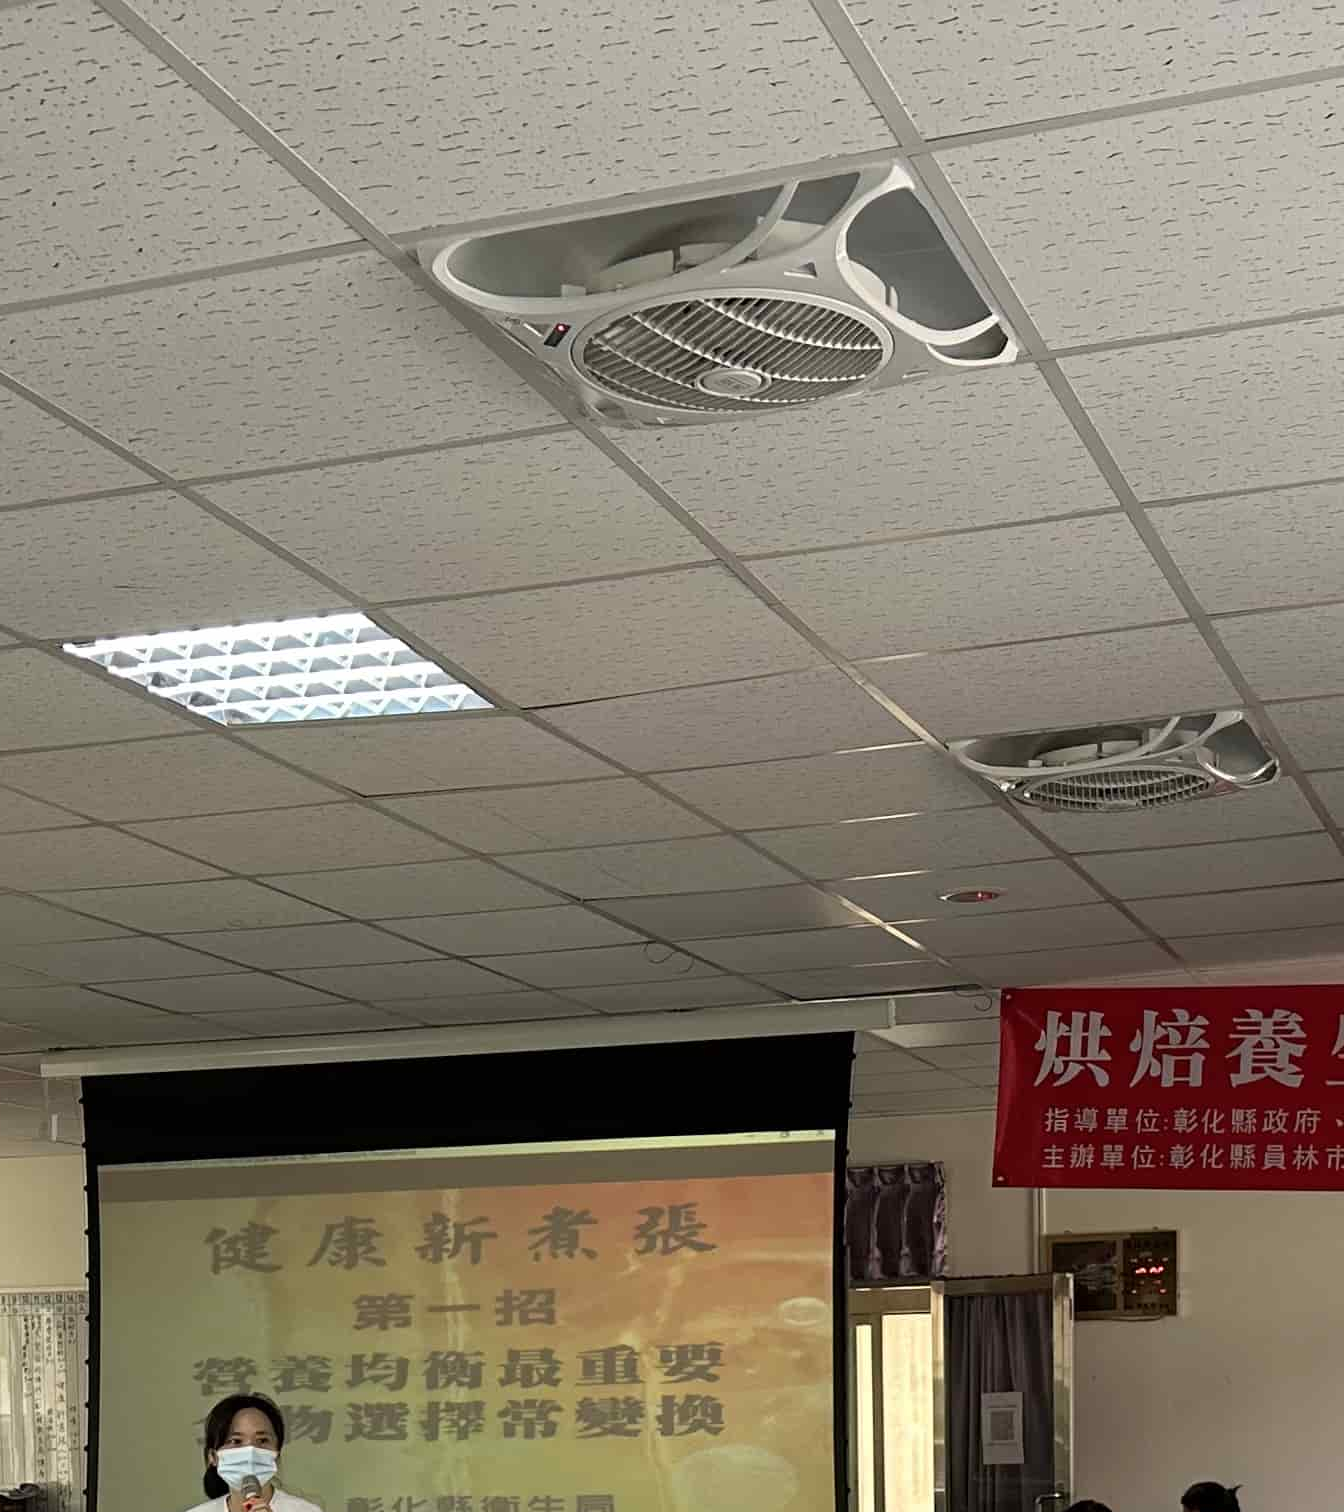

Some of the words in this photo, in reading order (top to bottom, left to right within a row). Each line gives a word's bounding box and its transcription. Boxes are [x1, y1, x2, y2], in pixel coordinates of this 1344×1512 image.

[202, 1202, 720, 1275] 健康新煮張
[353, 1287, 557, 1332] 第一招
[193, 1340, 726, 1397] 營養均衡最重要
[195, 1394, 726, 1446] 物選擇常變換
